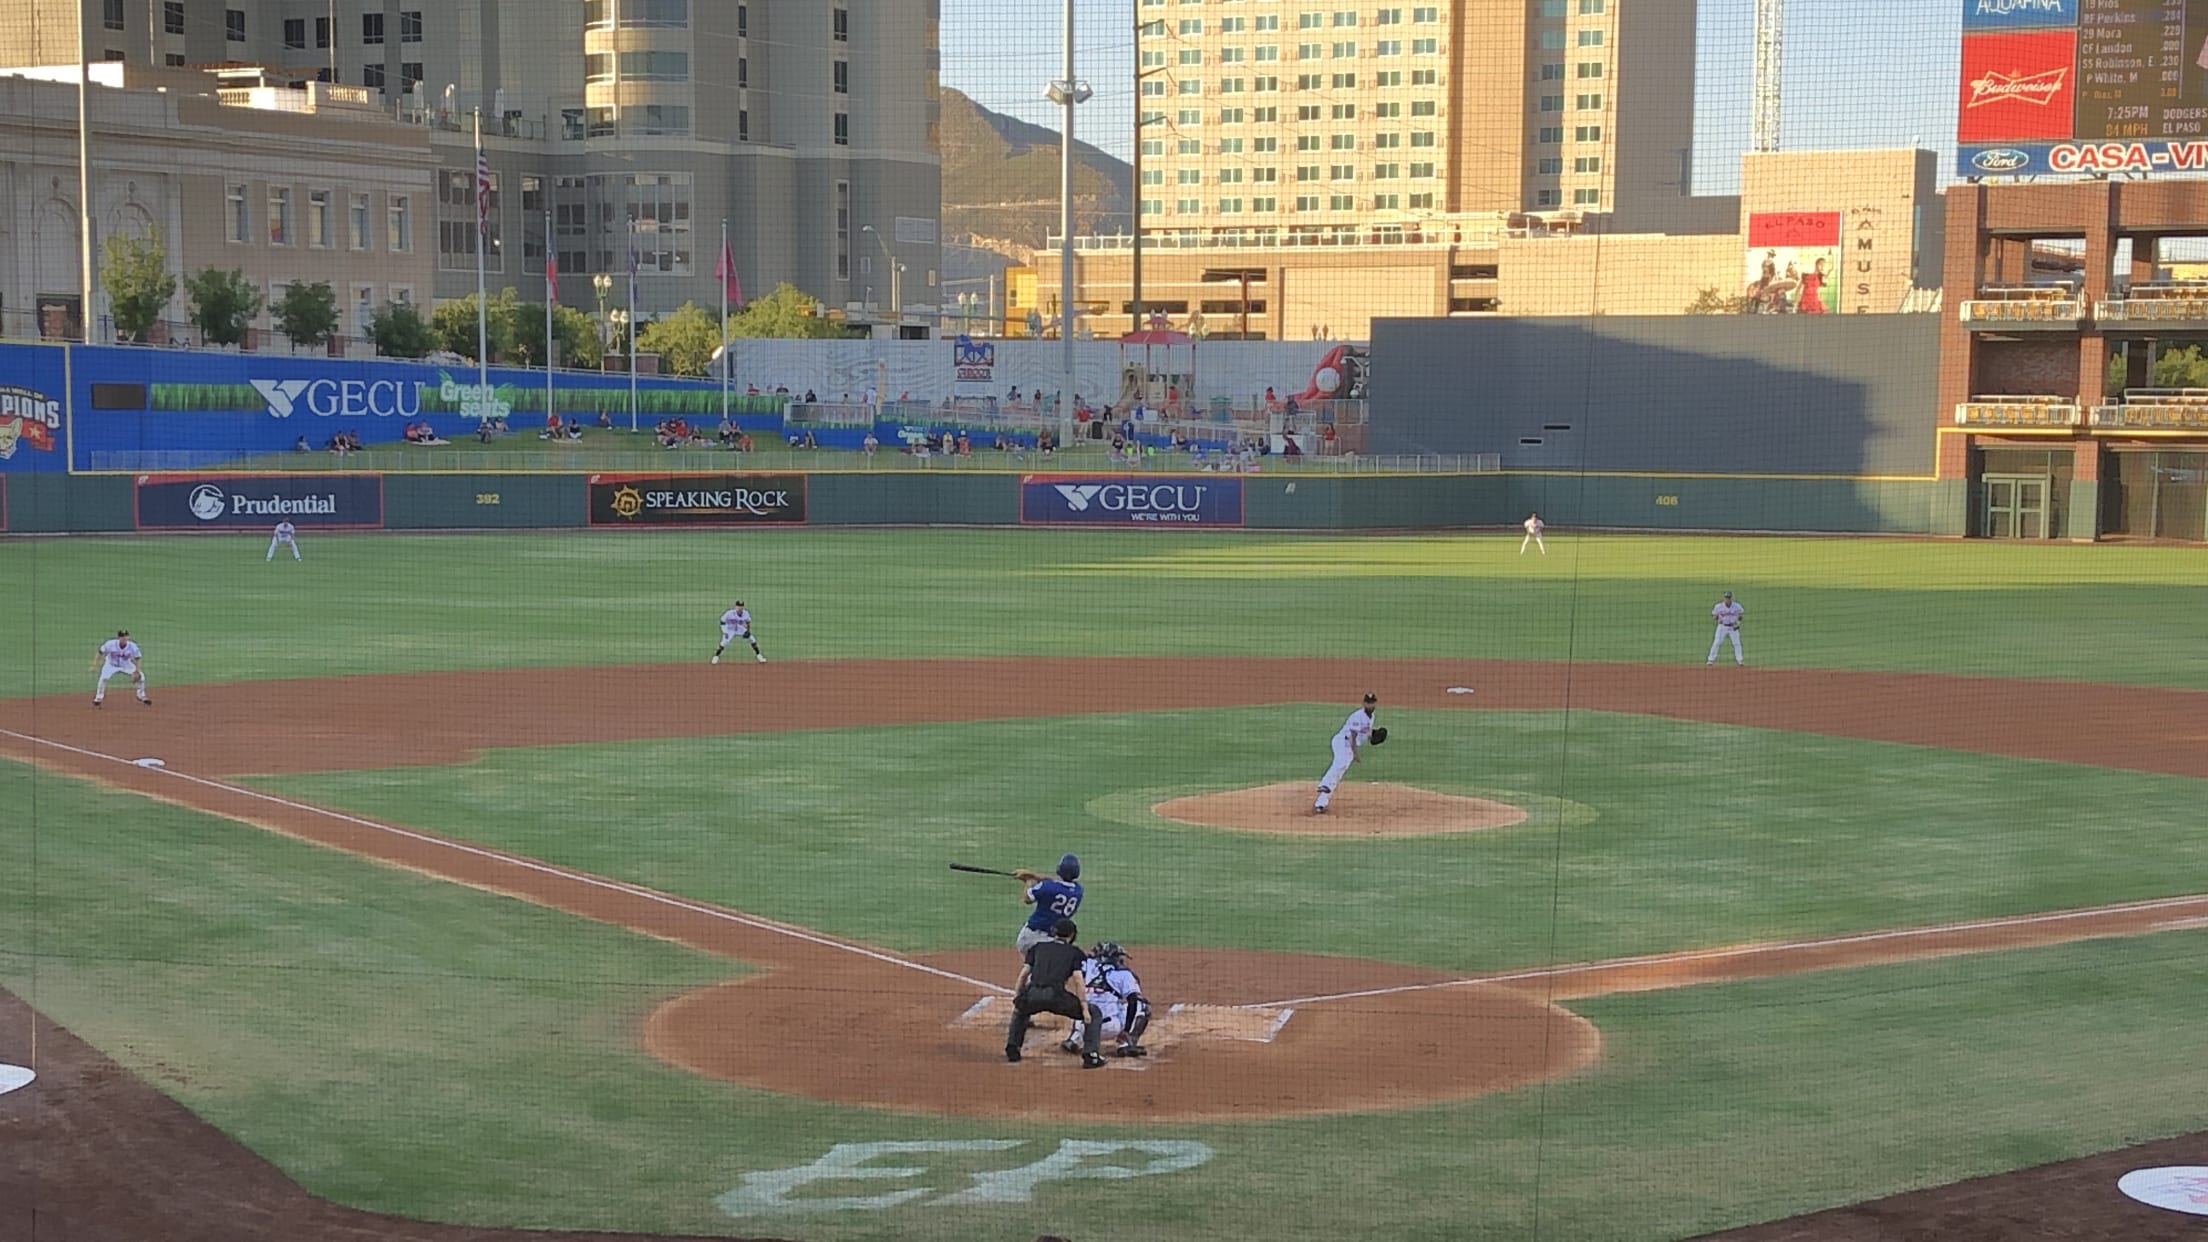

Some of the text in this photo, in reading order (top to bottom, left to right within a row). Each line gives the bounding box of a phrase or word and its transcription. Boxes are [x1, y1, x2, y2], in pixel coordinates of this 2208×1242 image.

[2097, 12, 2136, 24] Perkins
[2096, 28, 2122, 39] Mora
[2082, 43, 2094, 54] CF
[2082, 58, 2093, 69] SS
[1970, 79, 2062, 95] Budweiser
[2108, 105, 2149, 119] 7:25PM
[2163, 107, 2208, 120] DODGERS
[2123, 122, 2148, 136] MPH
[2163, 121, 2201, 134] EL PASO
[1983, 150, 2018, 167] Ford
[2049, 141, 2208, 173] CASA-VI
[306, 379, 422, 417] GECU
[232, 495, 336, 514] Prudential
[476, 493, 500, 504] 392
[646, 488, 789, 515] SPEAKING ROCK
[1098, 485, 1203, 511] GECU
[1182, 513, 1200, 521] YOU
[1050, 893, 1078, 917] 28
[719, 1138, 1214, 1217] EP
